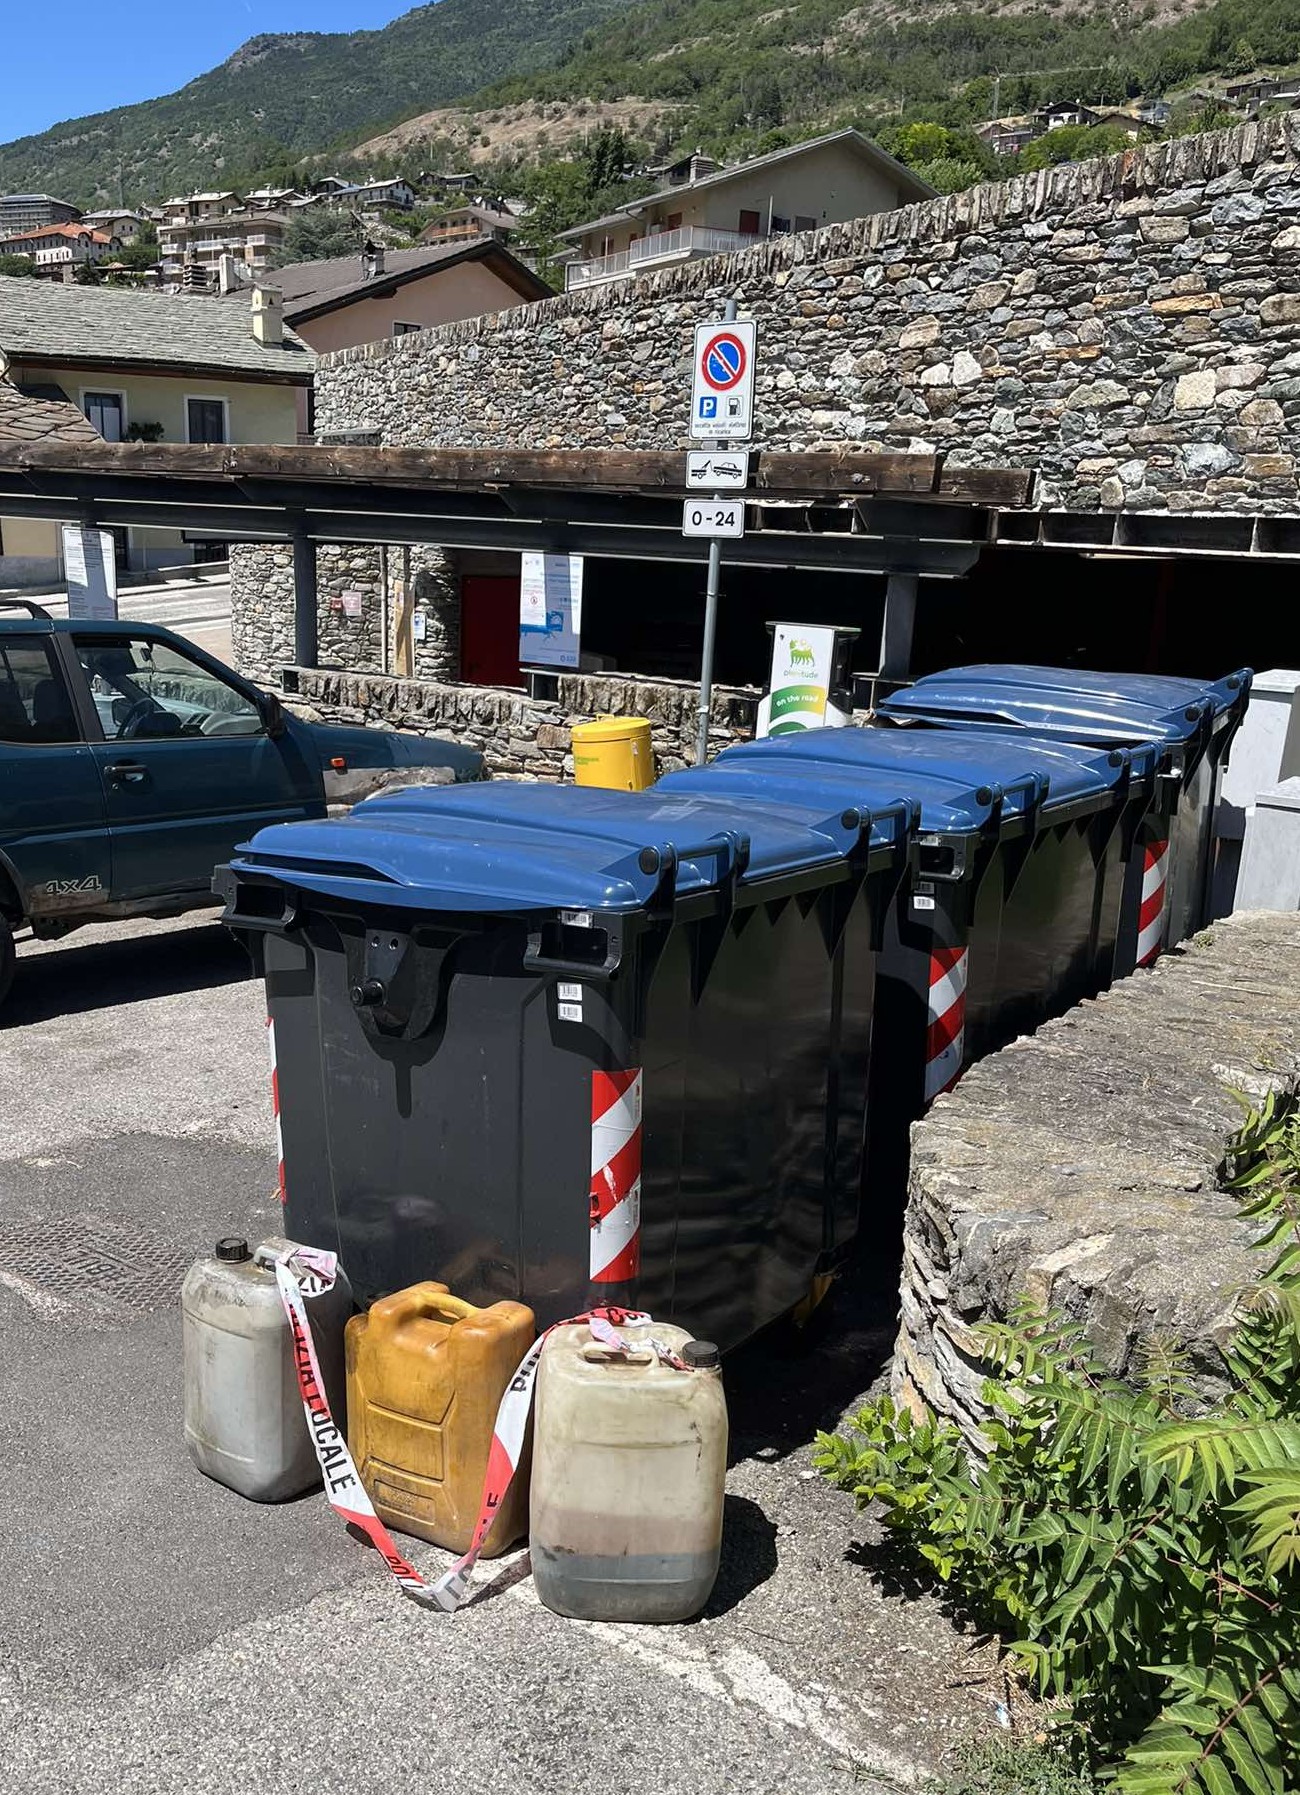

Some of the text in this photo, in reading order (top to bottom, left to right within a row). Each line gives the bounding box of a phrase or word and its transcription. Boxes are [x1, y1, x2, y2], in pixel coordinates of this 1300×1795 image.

[702, 399, 714, 415] P
[776, 699, 787, 707] on
[787, 693, 800, 703] the
[385, 1555, 424, 1589] POLI
